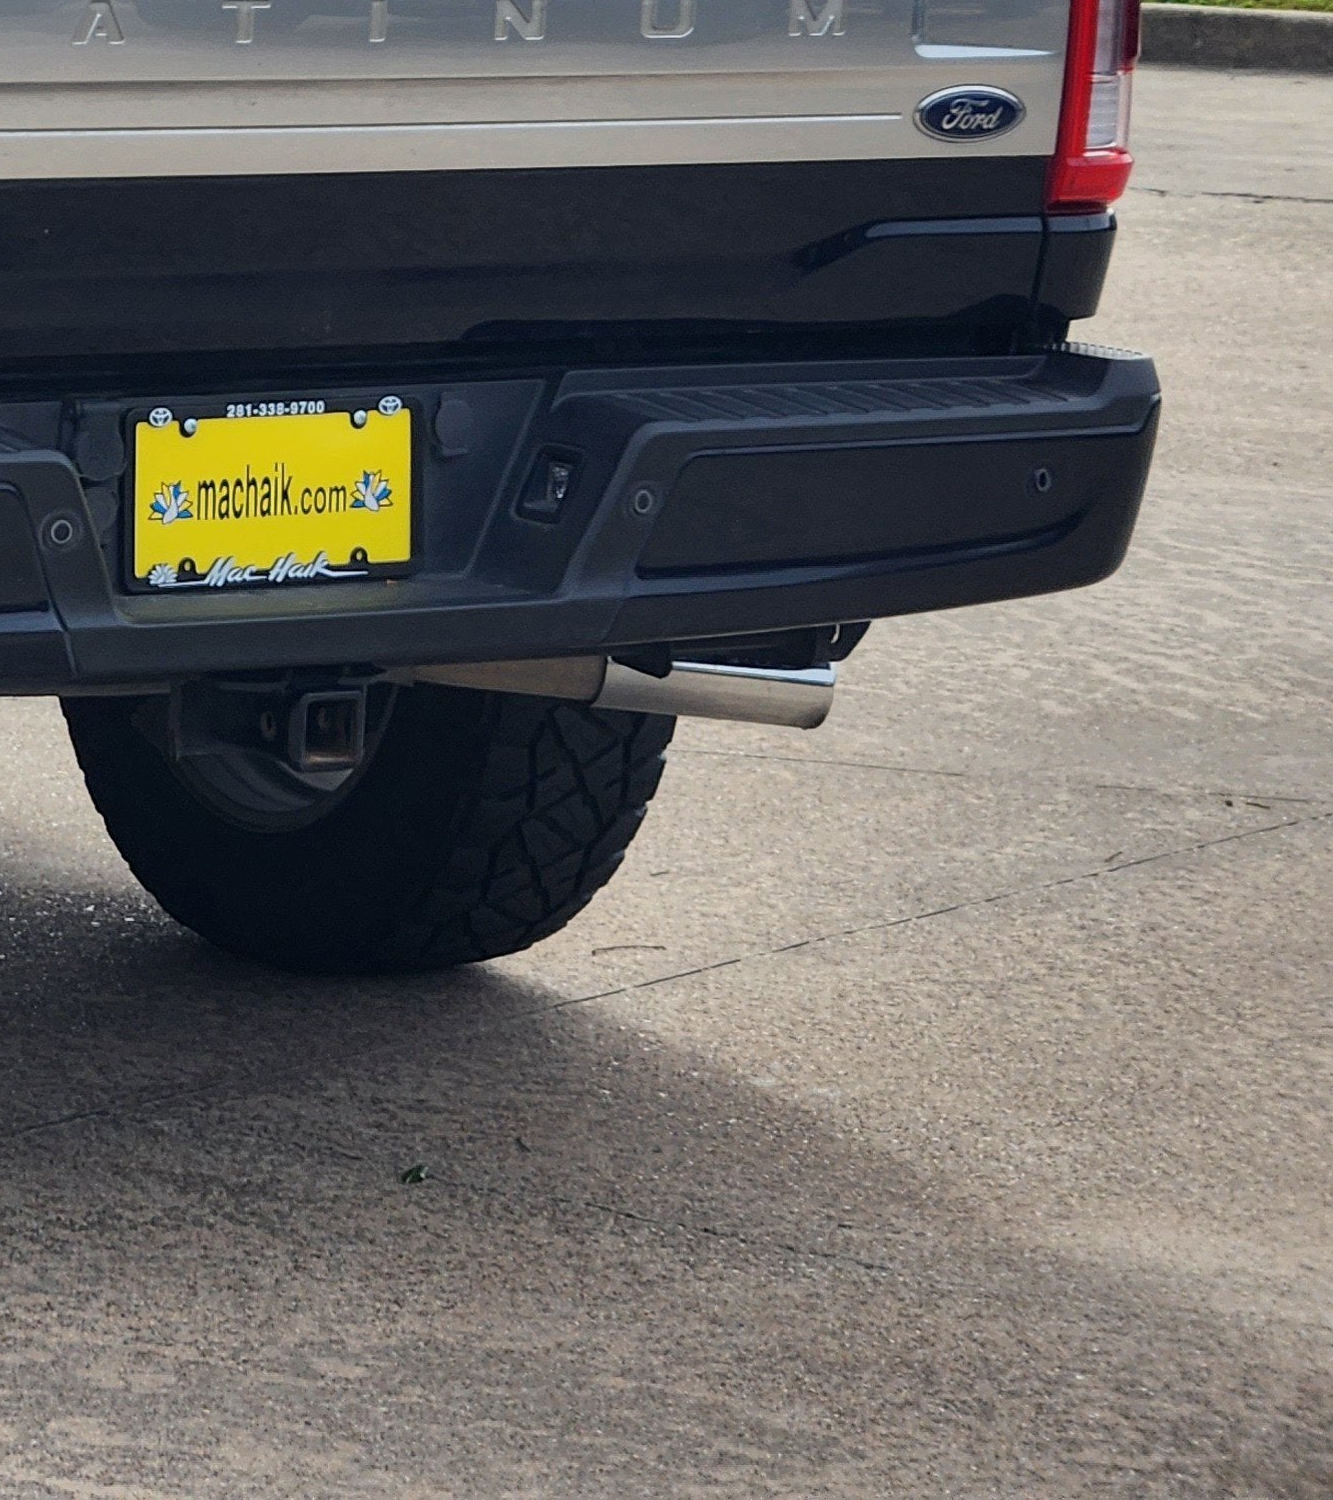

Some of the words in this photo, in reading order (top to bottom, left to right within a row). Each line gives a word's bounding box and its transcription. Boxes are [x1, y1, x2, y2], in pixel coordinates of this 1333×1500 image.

[942, 98, 1003, 130] Ford
[196, 462, 347, 521] machaik.com
[204, 556, 267, 587] Mac
[268, 551, 368, 583] Haik
